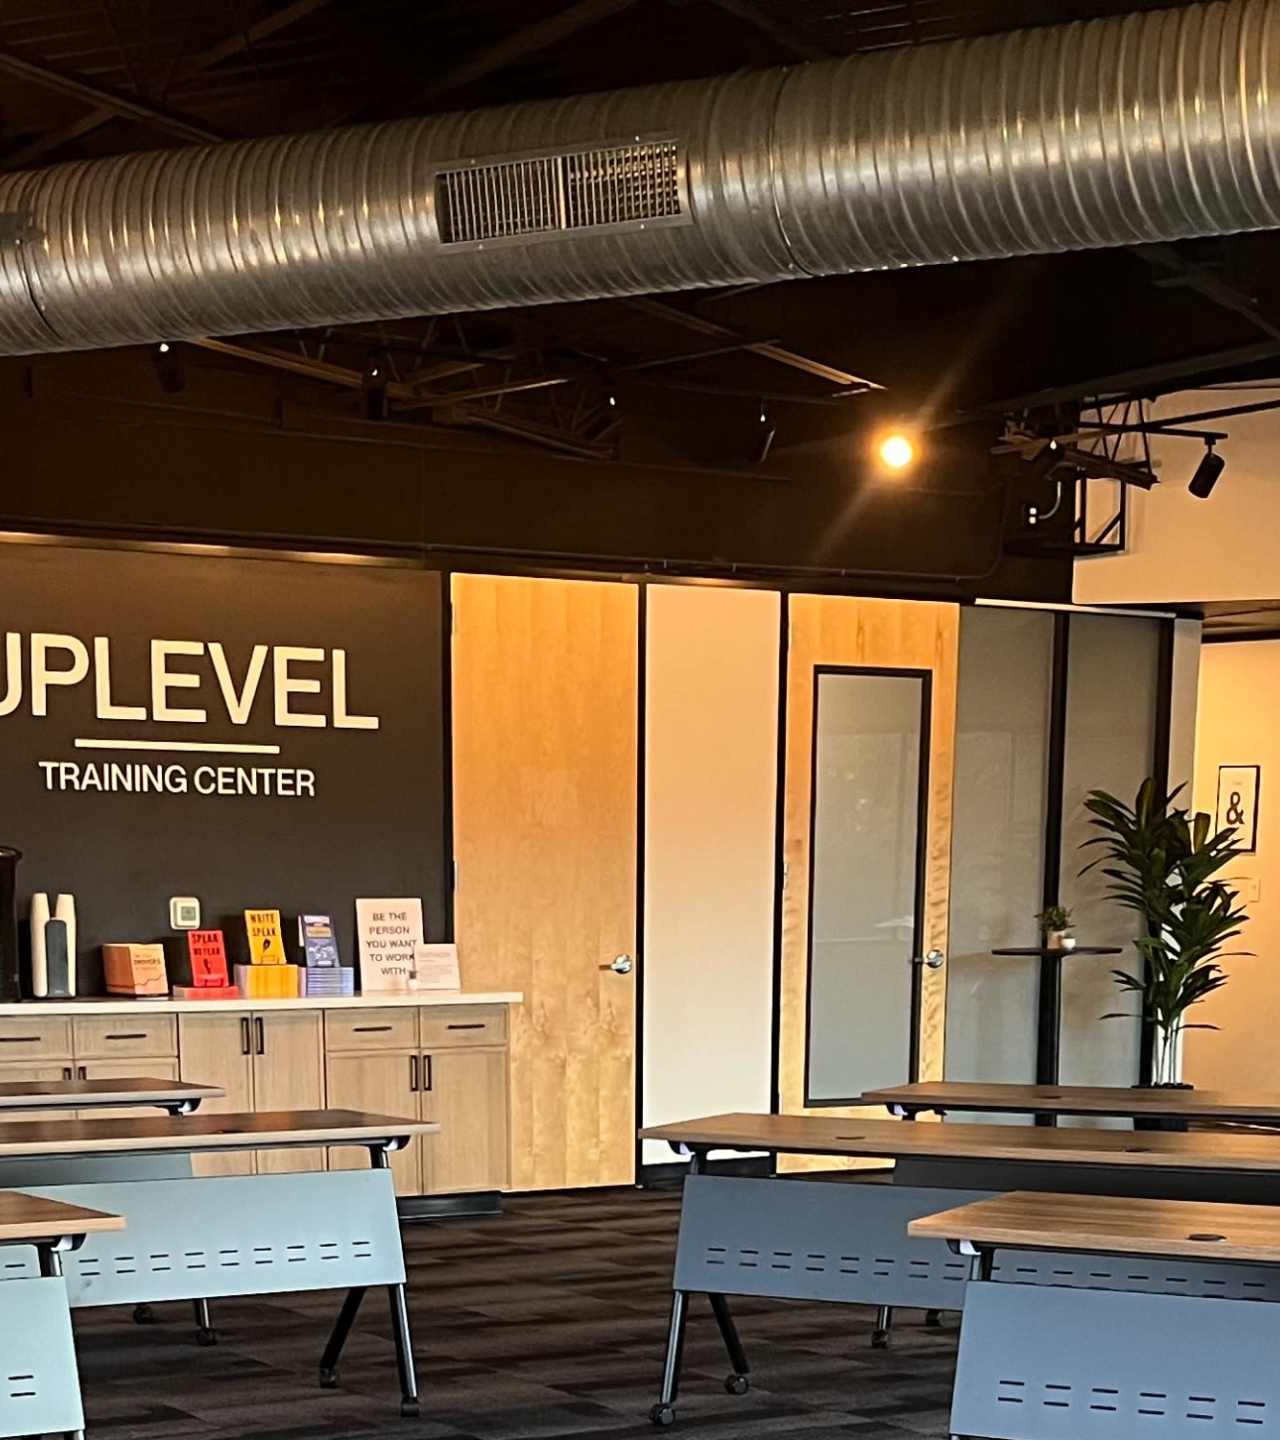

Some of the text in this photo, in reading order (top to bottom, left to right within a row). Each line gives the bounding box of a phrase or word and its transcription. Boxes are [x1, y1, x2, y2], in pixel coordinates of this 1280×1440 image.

[38, 761, 316, 797] TRAINING CENTER
[250, 913, 275, 923] WRITE
[372, 911, 408, 921] BE THE
[252, 927, 277, 937] SPEAK
[368, 926, 411, 935] PERSON
[191, 933, 219, 945] SPEAK
[366, 939, 417, 949] YOU WANT
[369, 953, 383, 962] TO
[380, 967, 407, 976] WITH
